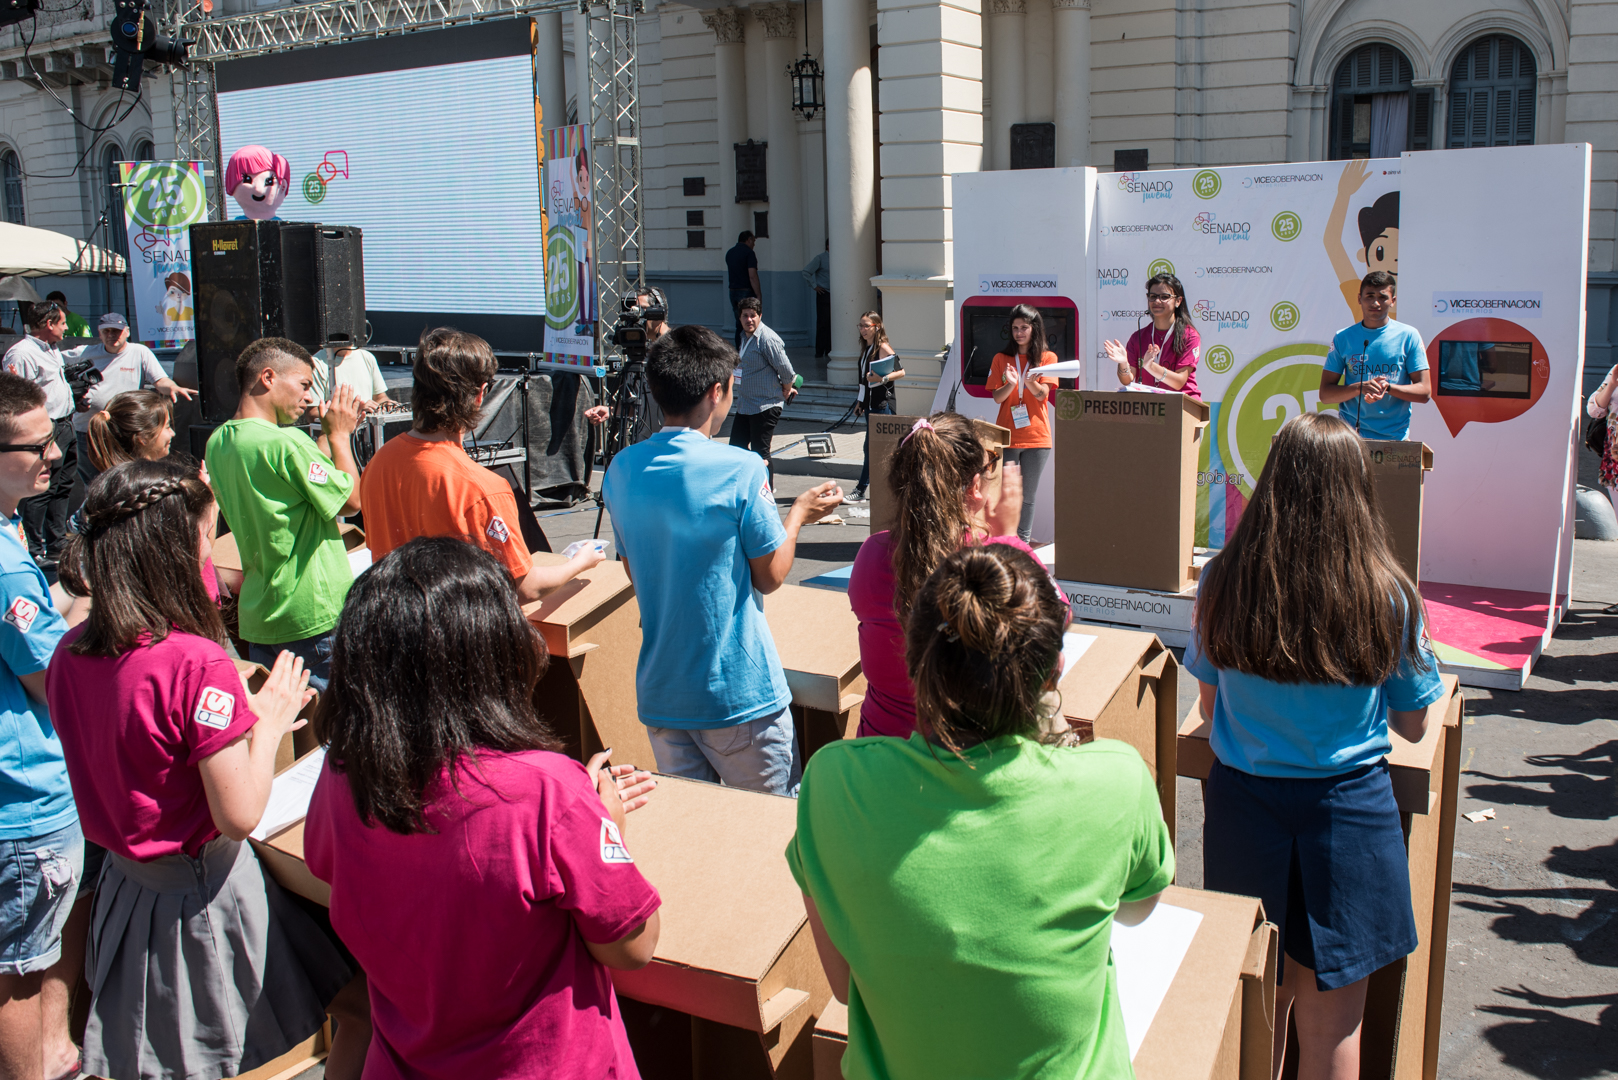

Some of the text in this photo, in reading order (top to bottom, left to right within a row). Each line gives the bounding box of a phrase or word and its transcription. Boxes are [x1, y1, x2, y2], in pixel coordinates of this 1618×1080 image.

[308, 180, 320, 193] 25
[1127, 181, 1173, 193] SENADO
[1200, 176, 1214, 190] 25
[143, 175, 184, 210] 25
[1143, 187, 1172, 203] juvenil
[553, 196, 588, 214] SENADO
[152, 206, 187, 219] AÑOS
[1202, 222, 1251, 234] SENADO
[1279, 218, 1294, 231] 25
[1219, 229, 1250, 245] juvenil
[548, 250, 569, 294] 25
[1097, 268, 1128, 278] NADO
[1099, 275, 1128, 289] juvenil
[549, 292, 571, 307] AÑOS
[1201, 311, 1250, 321] SENADO
[1278, 308, 1292, 321] 25
[1218, 318, 1249, 332] juvenil
[1212, 352, 1227, 364] 25
[1352, 364, 1399, 375] SENADO
[1060, 397, 1075, 411] 25
[1084, 400, 1166, 416] PRESIDENTE
[1386, 455, 1422, 463] SENADO
[1196, 469, 1244, 486] gob.ar
[1073, 605, 1094, 613] NTRE
